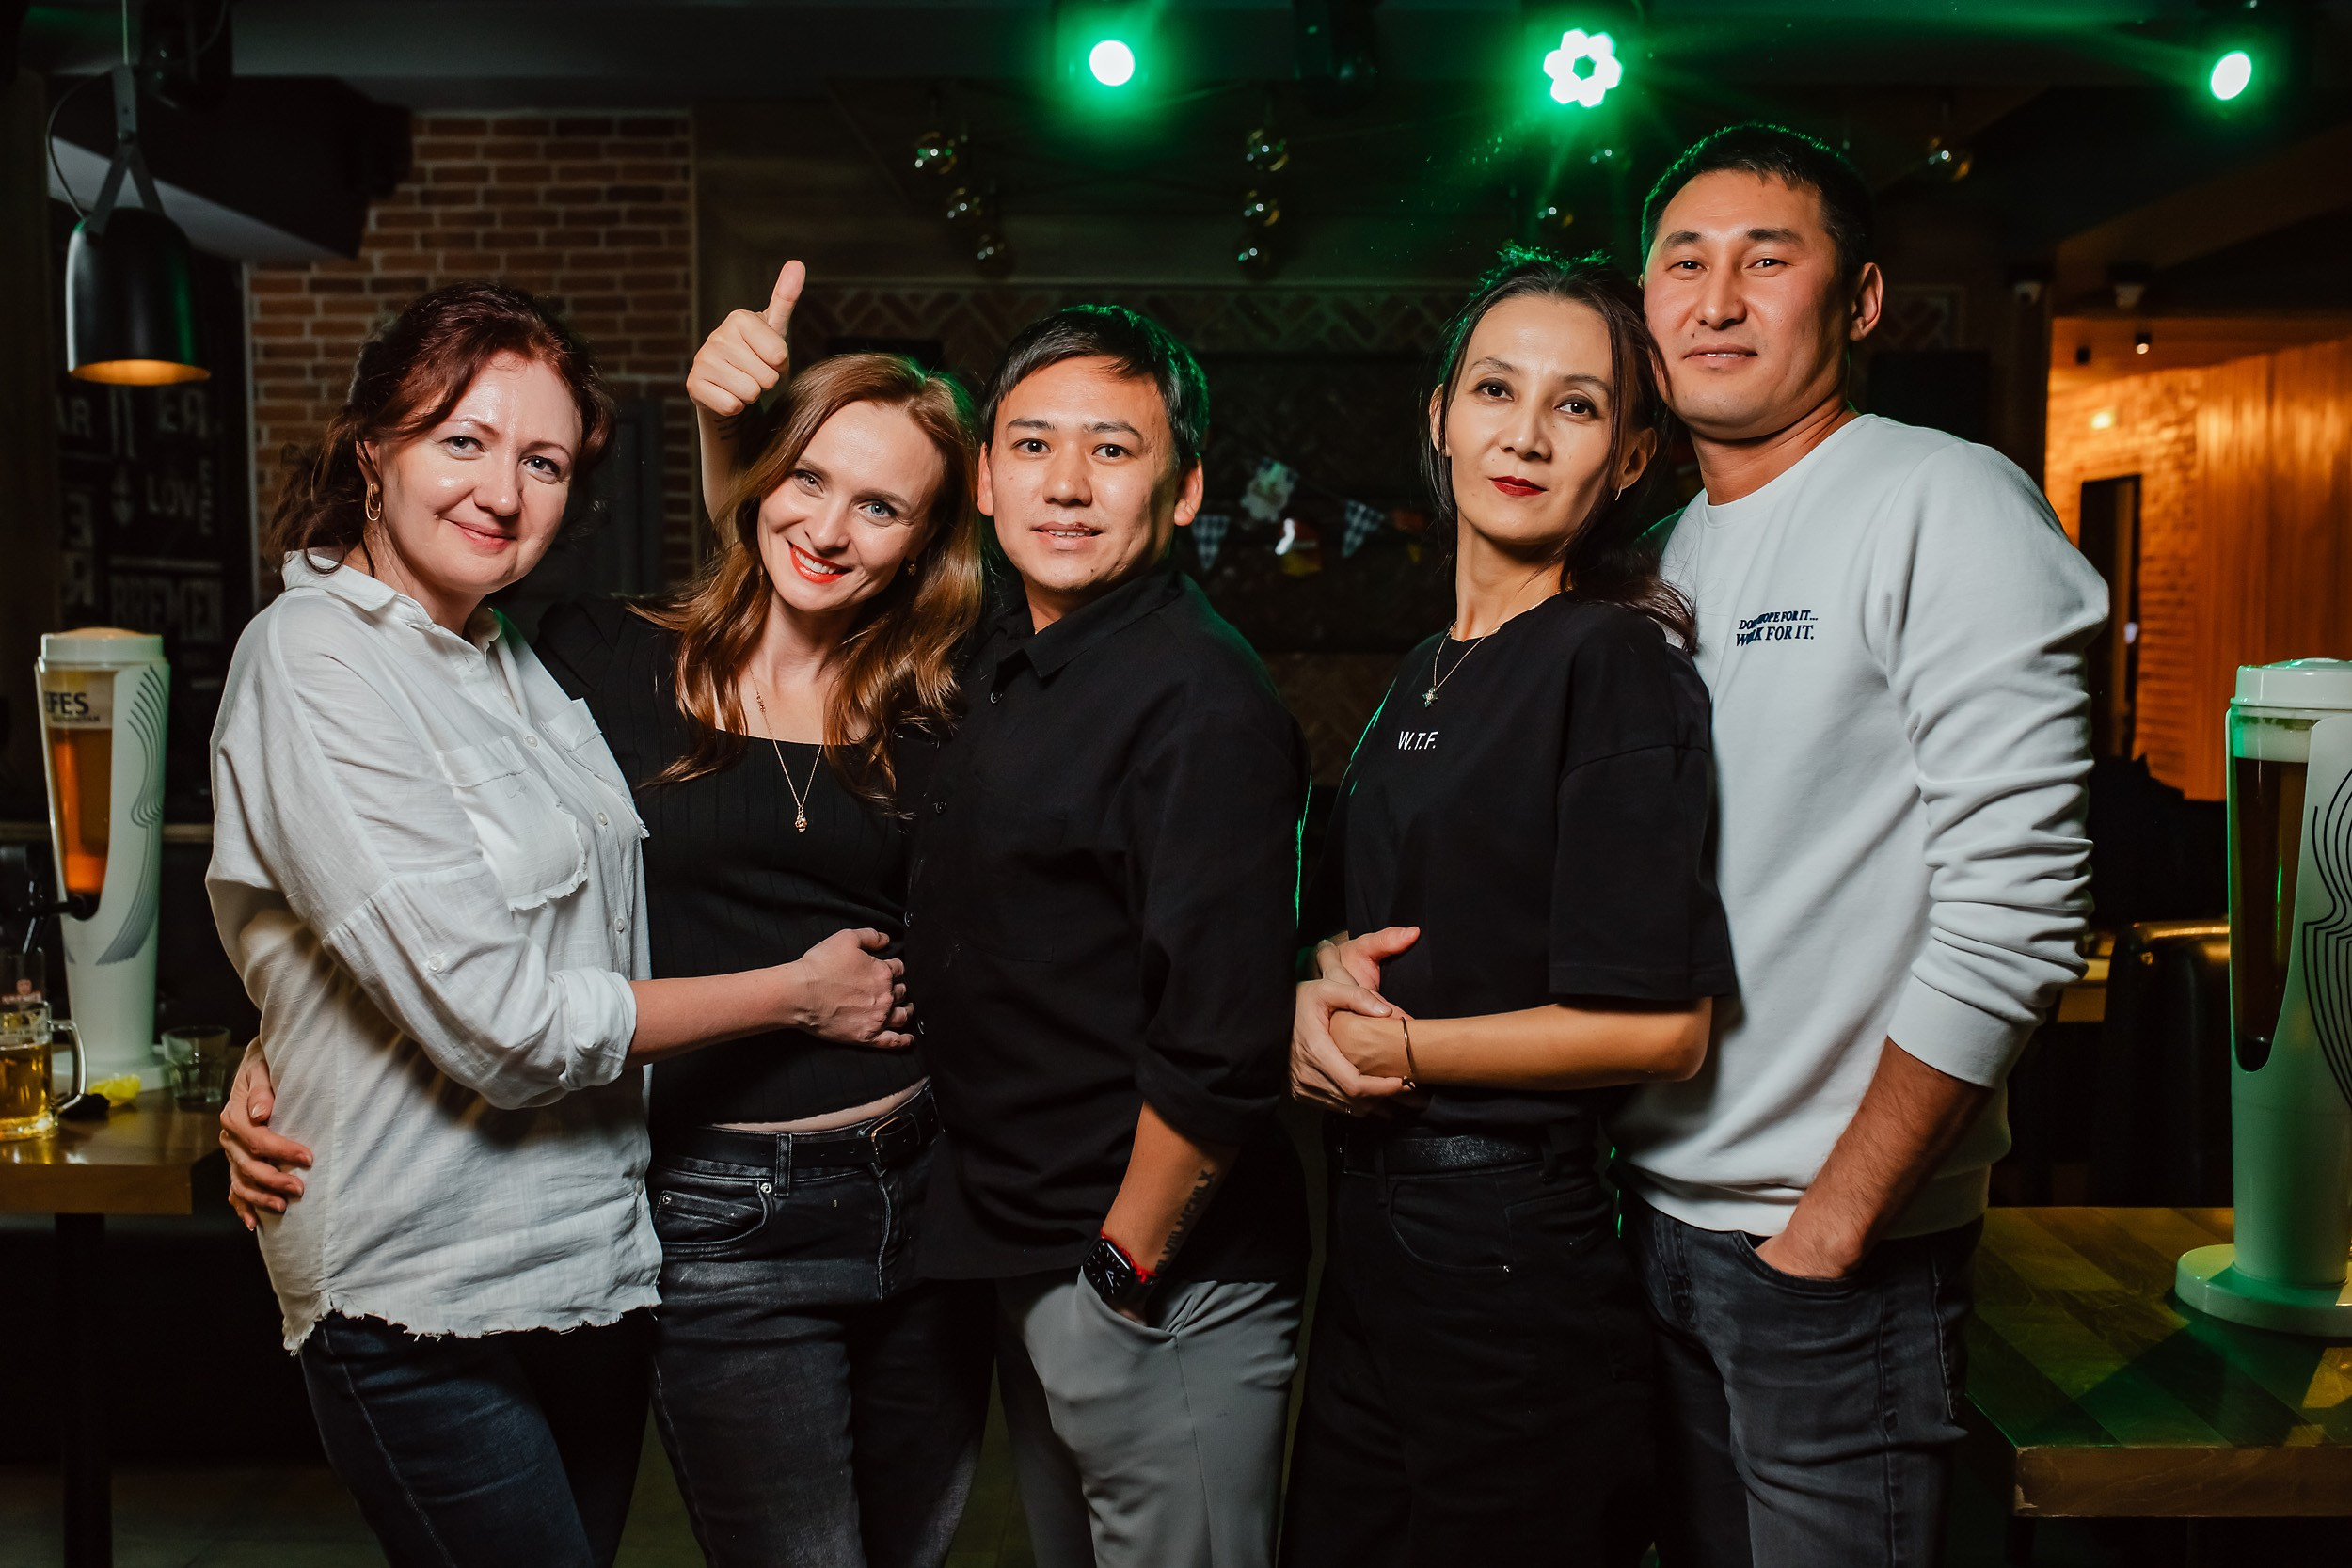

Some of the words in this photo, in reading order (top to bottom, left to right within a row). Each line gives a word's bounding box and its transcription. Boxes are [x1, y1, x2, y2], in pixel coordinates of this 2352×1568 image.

[1780, 610, 1799, 622] FOR
[1765, 625, 1792, 641] FOR
[1795, 624, 1814, 640] IT.
[1398, 730, 1439, 751] W.T.F.
